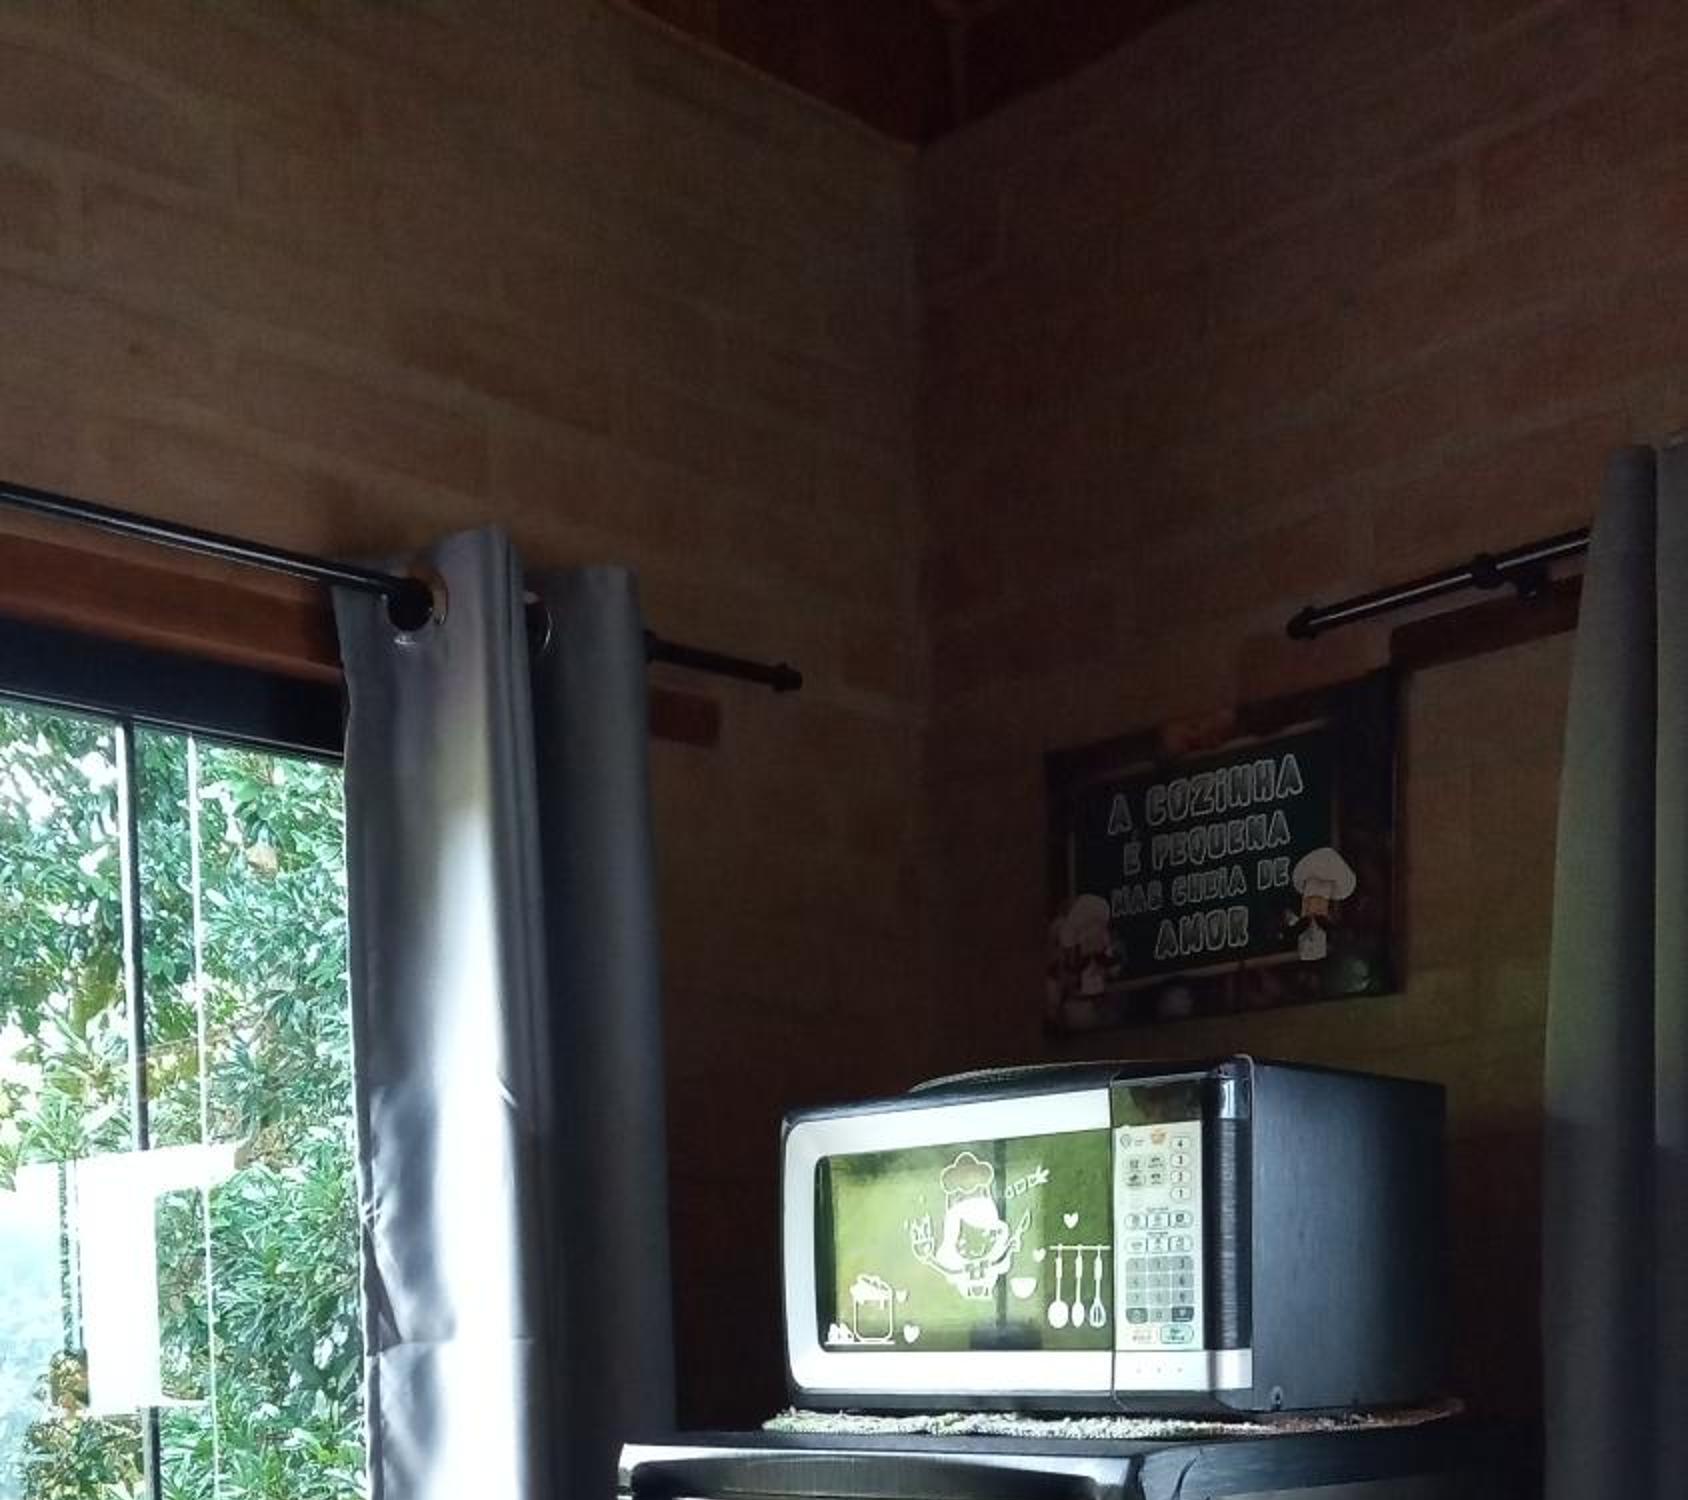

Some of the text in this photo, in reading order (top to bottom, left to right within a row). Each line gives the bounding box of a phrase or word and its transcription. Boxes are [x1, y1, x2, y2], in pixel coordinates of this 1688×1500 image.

[1107, 753, 1303, 836] A COZINHA
[1151, 810, 1291, 871] PEQUENA
[1110, 856, 1291, 918] MAS CHEIA DE
[1154, 905, 1249, 960] AMOR
